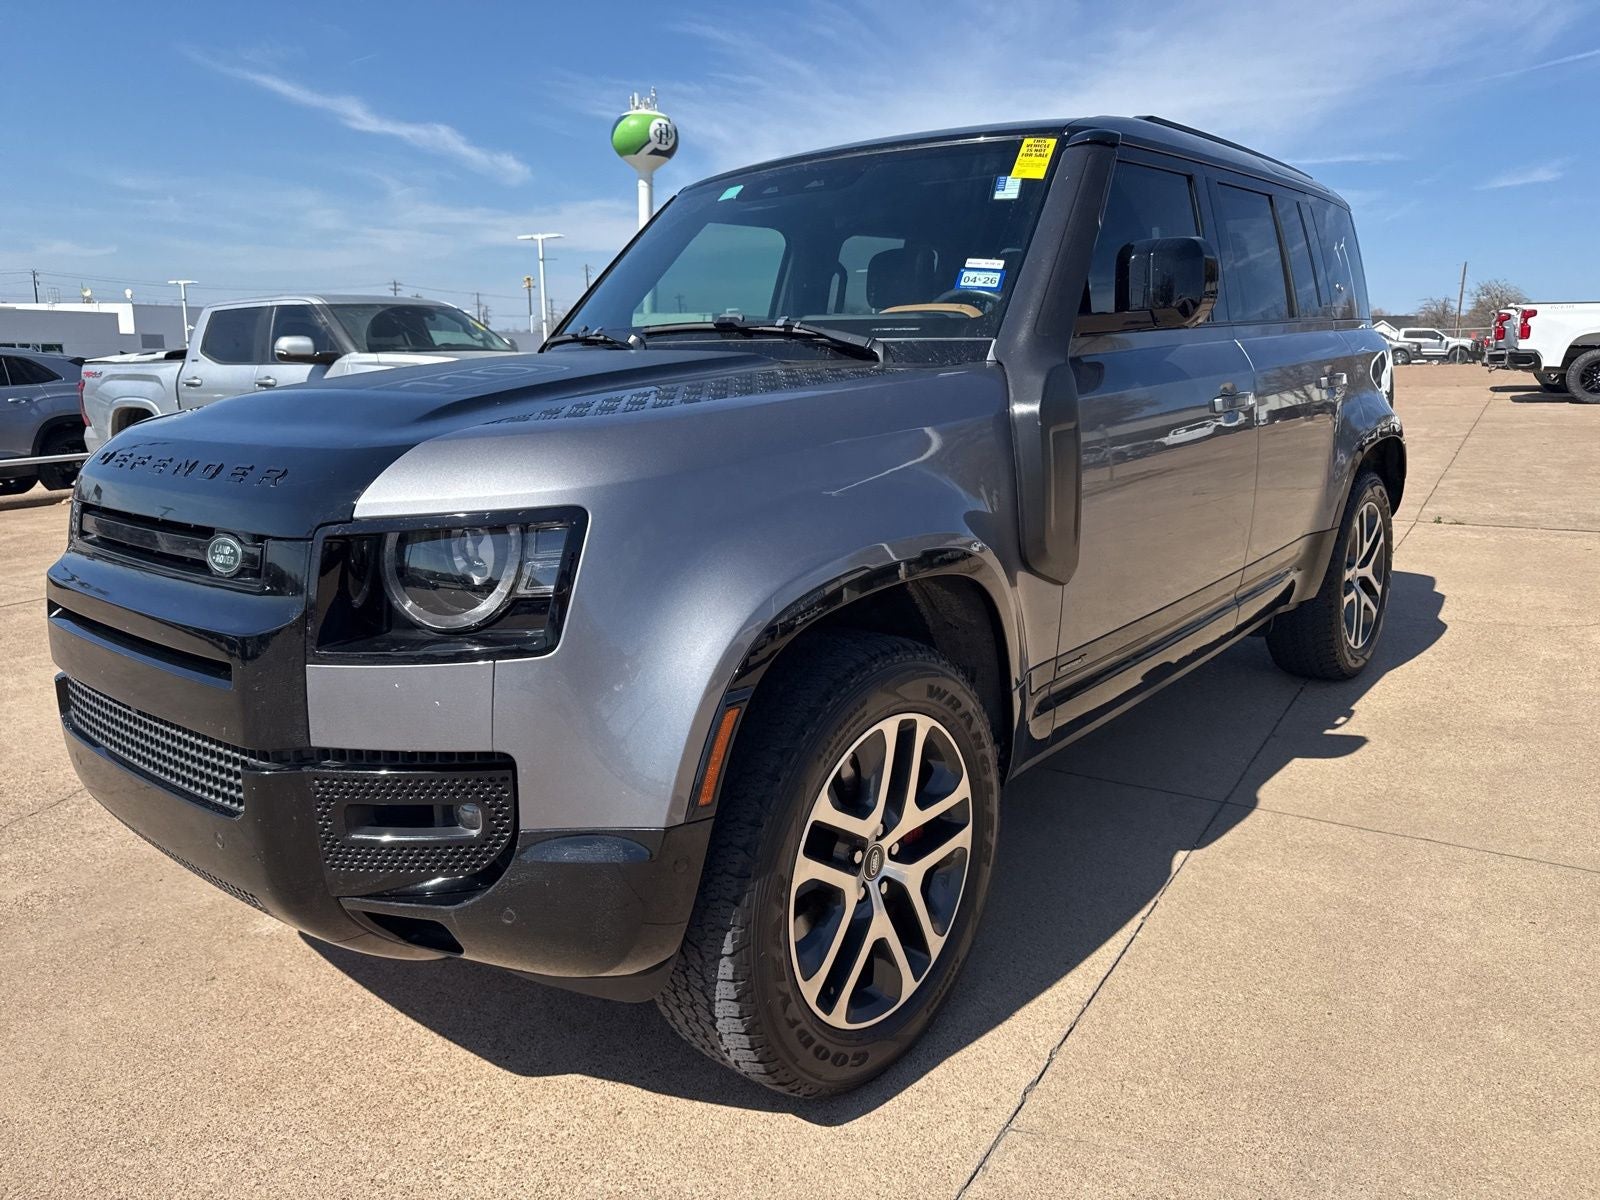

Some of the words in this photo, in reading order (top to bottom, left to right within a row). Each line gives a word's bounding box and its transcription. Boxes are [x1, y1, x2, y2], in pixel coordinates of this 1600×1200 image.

[982, 276, 998, 285] 26
[101, 451, 289, 487] DEFENDER
[215, 544, 231, 555] LAND
[214, 554, 235, 565] ROVER
